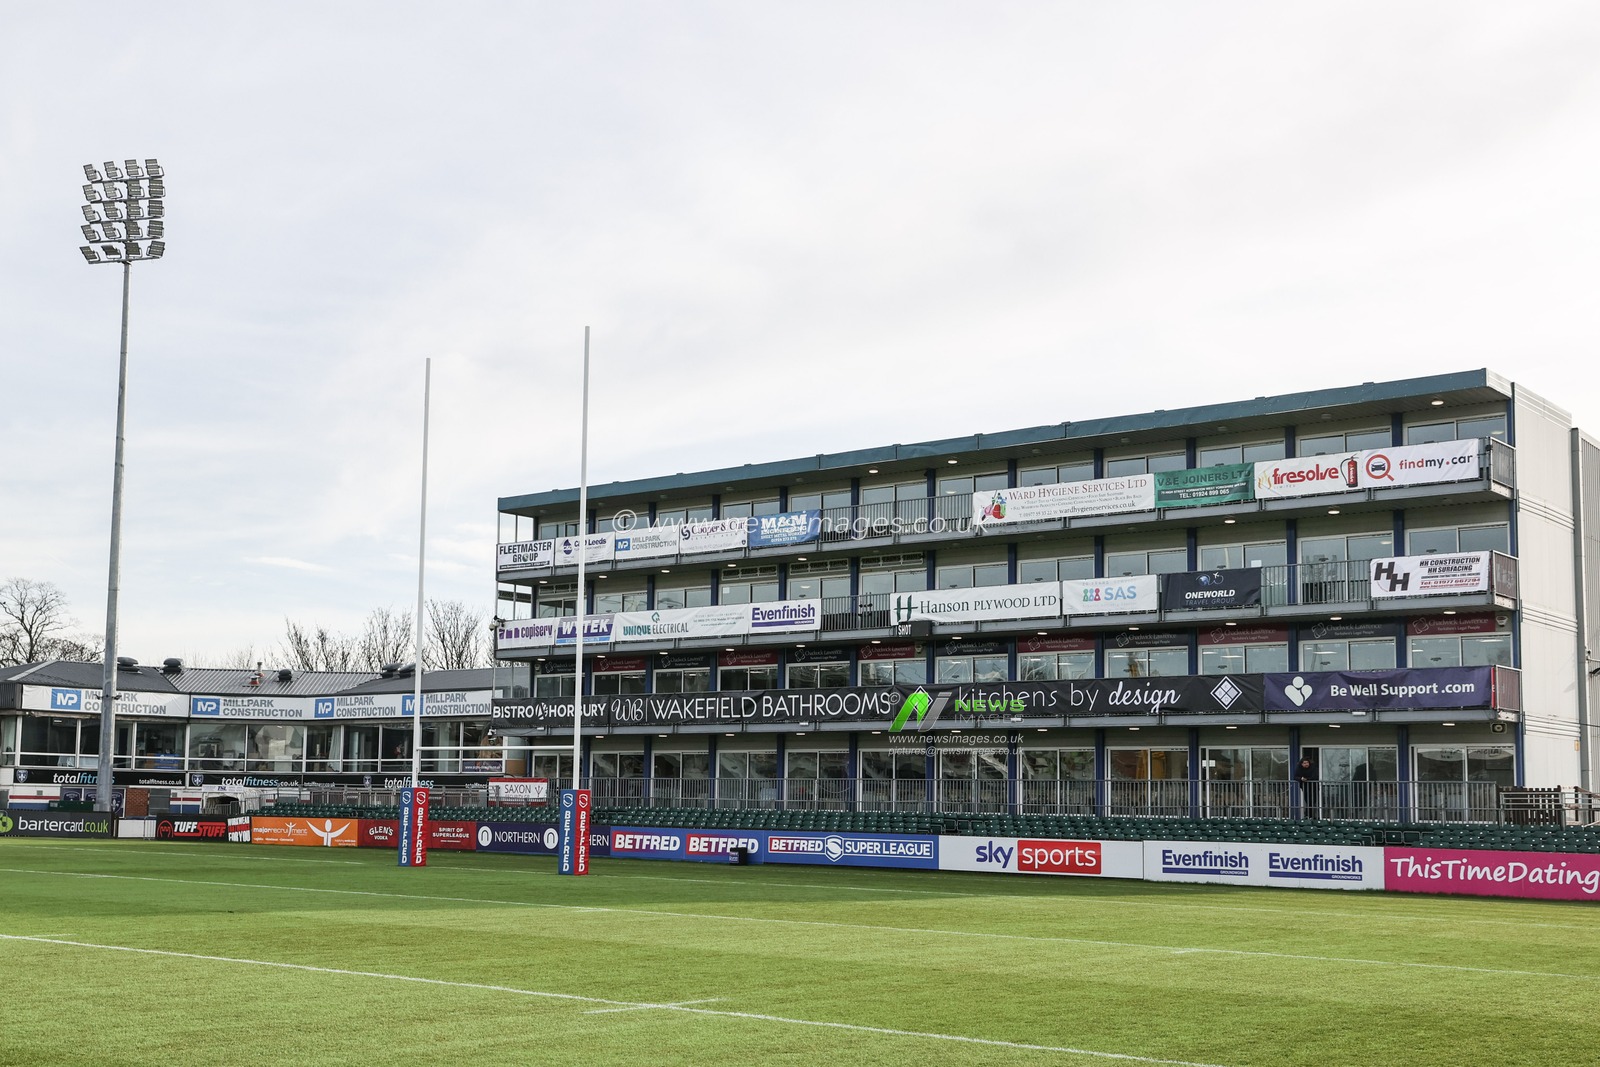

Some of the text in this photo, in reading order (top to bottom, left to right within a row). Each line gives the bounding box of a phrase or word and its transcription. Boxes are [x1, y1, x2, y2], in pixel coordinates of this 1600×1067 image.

[1399, 454, 1472, 470] findmy.car
[1158, 471, 1250, 486] V&E JOINERS LTD
[1272, 464, 1338, 484] firesolve
[1009, 491, 1035, 500] WARD
[1038, 487, 1079, 498] HYGIENE
[1082, 482, 1124, 494] SERVICES
[1128, 479, 1146, 488] LTD
[1059, 501, 1135, 514] wardhygieneservices.co.uk
[761, 514, 807, 529] M&M
[632, 535, 660, 543] MILLPARK
[632, 540, 677, 550] CONSTRUCTION
[500, 542, 551, 555] FLEETMASTER
[513, 553, 538, 562] GROUP
[1430, 557, 1480, 566] CONSTRUCTION
[1104, 586, 1136, 600] SAS
[1185, 590, 1235, 599] ONEWORLD
[921, 595, 1056, 613] Hanson PLYWOOD LTD
[752, 604, 815, 621] Evenfinish
[521, 624, 552, 639] copiserv
[563, 619, 609, 635] WTEK
[623, 623, 689, 636] UNIQUE ELECTRICAL
[898, 625, 911, 635] SHOT
[959, 681, 1181, 713] kitchens by design
[1331, 683, 1474, 699] Be Well Support .com
[57, 693, 78, 706] MP
[223, 699, 274, 707] MILLPARK
[337, 697, 374, 706] MILLPARK
[426, 693, 467, 703] MILLPARK
[85, 702, 166, 714] COTRUCTION
[197, 701, 216, 711] MP
[318, 702, 331, 714] MP
[336, 706, 395, 717] CONSTRUCTION
[426, 703, 490, 715] CONSTRUCTION
[493, 705, 534, 718] BISTRO
[651, 692, 891, 719] WAKEFIELD BATHROOMS
[223, 708, 302, 717] CONSTRUCTION
[222, 776, 298, 787] totalfitness.co.uk
[384, 777, 434, 789] totalfiness
[505, 784, 531, 793] SAXON
[18, 816, 108, 833] bartercard.co.uk
[369, 826, 393, 836] GLEN'S
[238, 830, 250, 842] YOU
[416, 808, 424, 864] BETFRED
[495, 831, 540, 843] NORTHERN
[563, 811, 571, 871] BETFRED
[615, 834, 680, 851] BETFRED
[689, 837, 759, 853] BETFRED
[771, 839, 930, 856] BETFRED SUPER LEAGUE
[976, 841, 1096, 869] sky sports
[1162, 850, 1248, 868] Evenfinish
[1269, 853, 1363, 872] Evenfinish
[1390, 856, 1600, 894] ThisTimeDating
